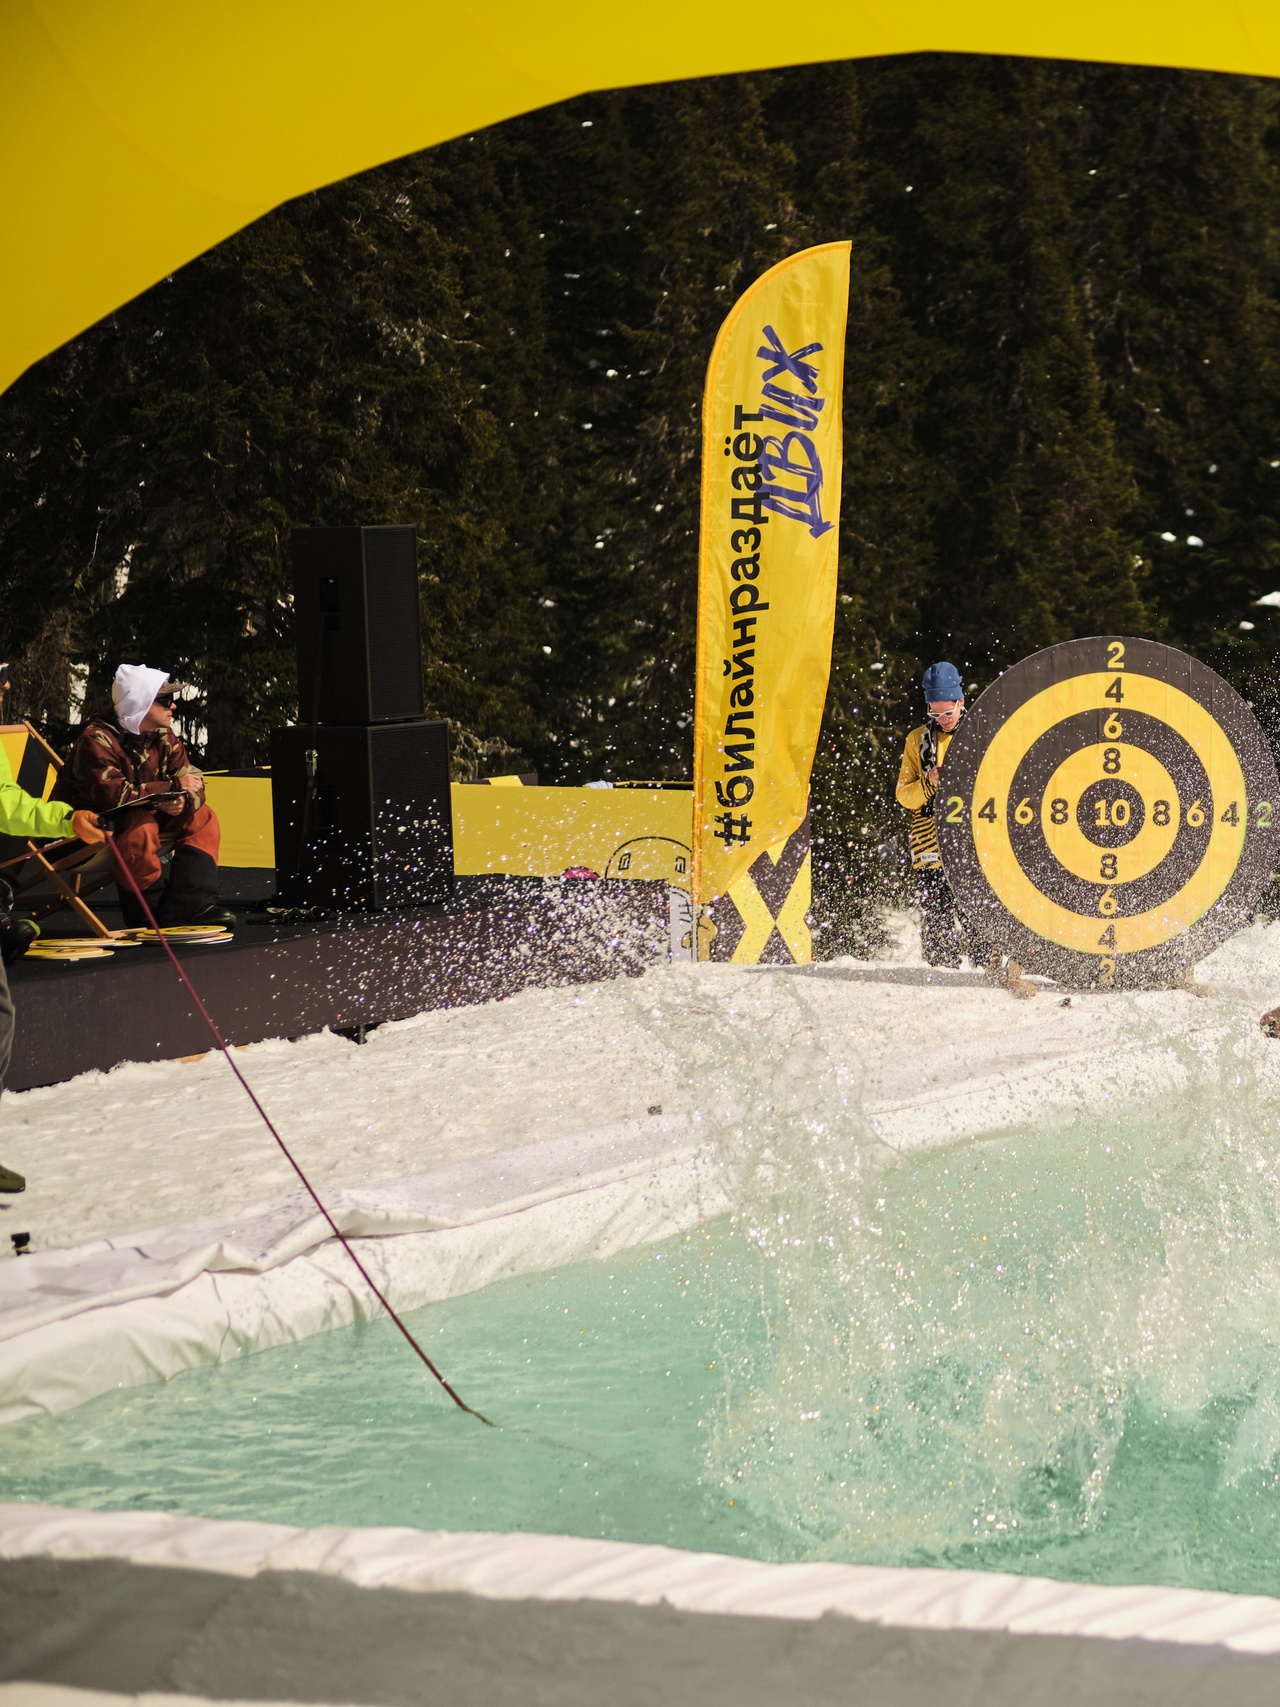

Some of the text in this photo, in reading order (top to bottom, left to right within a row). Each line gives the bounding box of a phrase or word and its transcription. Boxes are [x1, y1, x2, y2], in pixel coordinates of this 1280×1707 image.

[714, 405, 770, 847] #билайнраздаёт
[1107, 641, 1125, 668] 2
[1105, 678, 1124, 703] 4
[1103, 713, 1122, 739] 6
[1103, 748, 1121, 774] 8
[946, 796, 1272, 827] 2 4 6 8 10 8 6 4 2
[1100, 853, 1118, 880] 8
[1099, 889, 1117, 915] 6
[1098, 924, 1117, 950] 4
